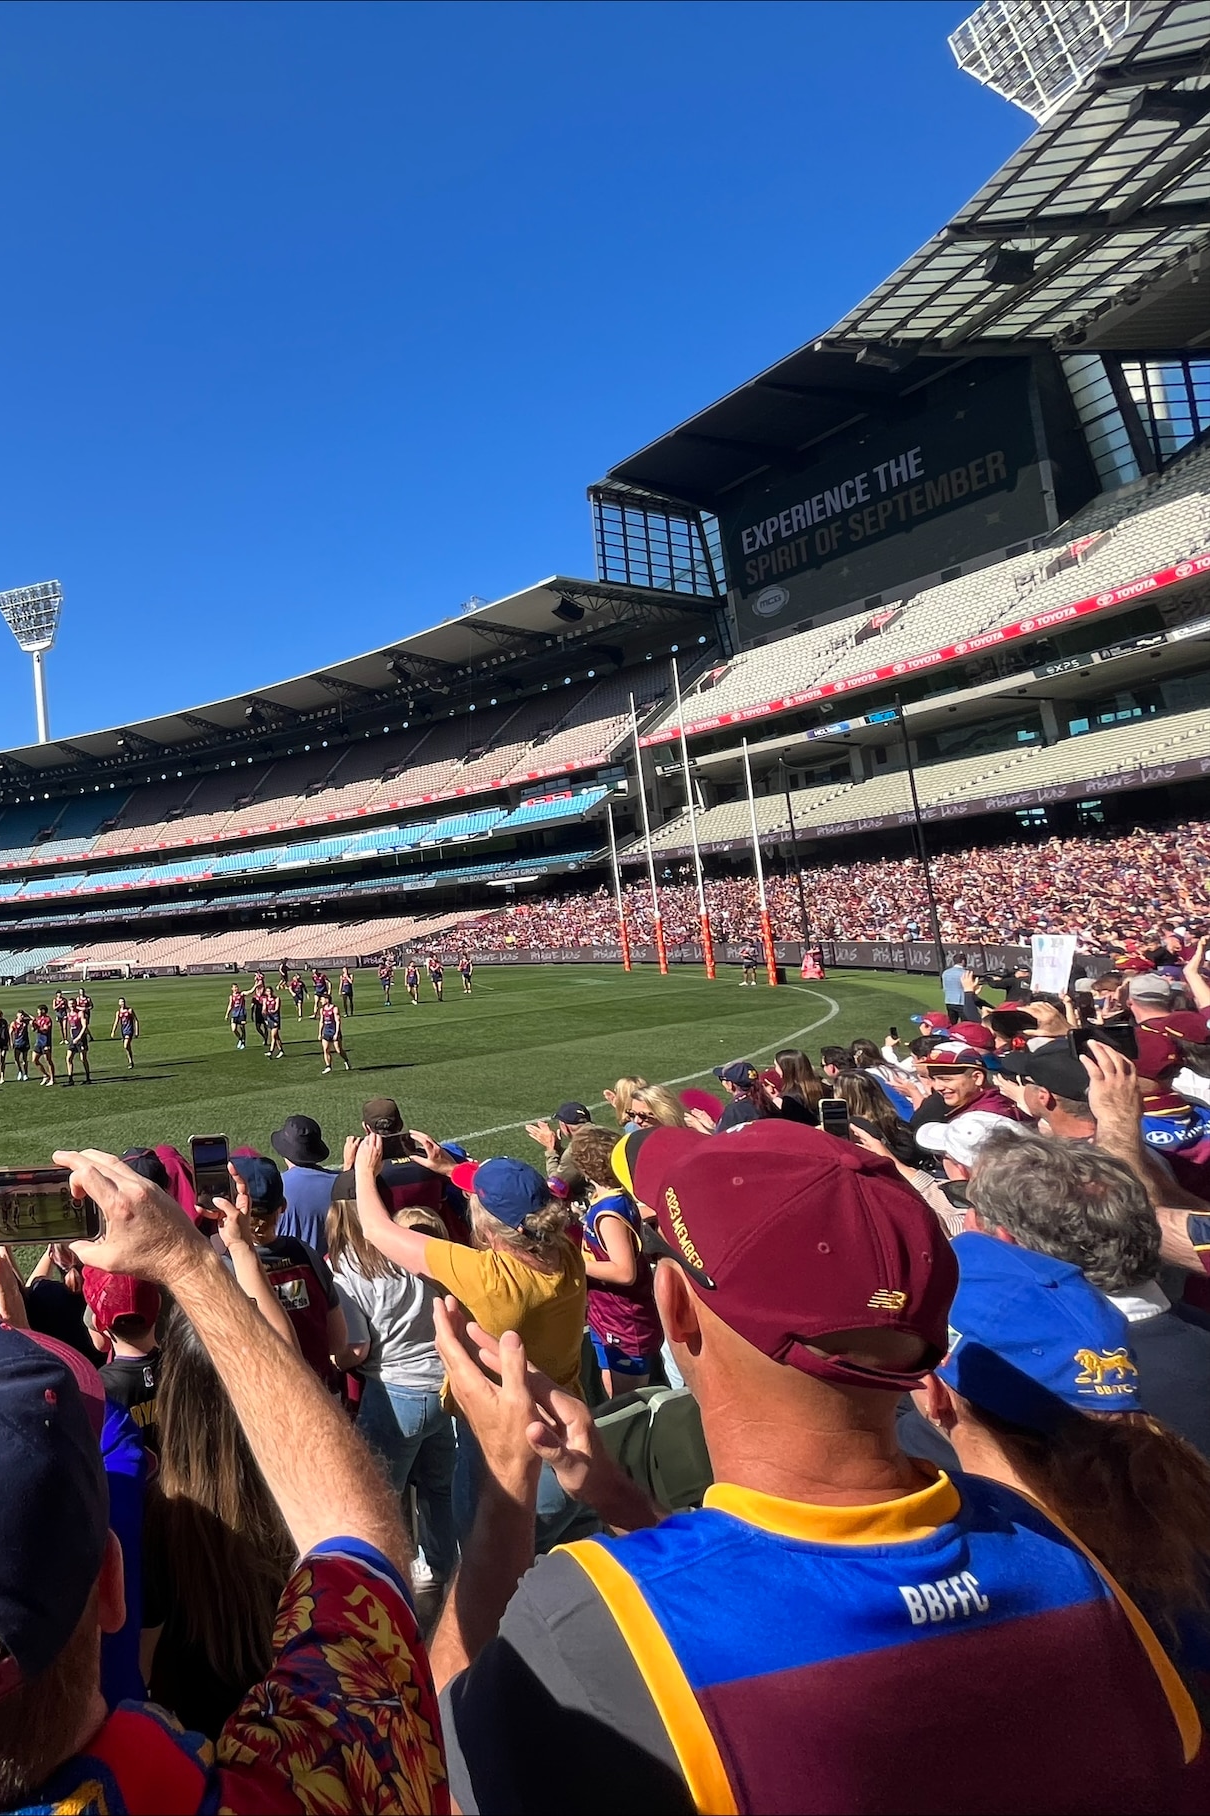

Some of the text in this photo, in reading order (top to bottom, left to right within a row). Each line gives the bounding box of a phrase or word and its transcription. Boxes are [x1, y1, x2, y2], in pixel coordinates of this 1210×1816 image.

[741, 446, 925, 554] EXPERIENCE THE
[745, 450, 1007, 585] SPIRIT OF SEPTEMBER
[1115, 578, 1157, 599] TOYOTA
[1036, 607, 1077, 626] TOYOTA
[968, 632, 1004, 649] TOYOTA
[907, 652, 942, 669] TOYOTA
[846, 672, 878, 687] TOYOTA
[795, 689, 822, 703] TOYOTA
[742, 705, 771, 718] TOYOTA
[694, 719, 720, 730] TOYOTA
[648, 732, 673, 742] TOYOTA
[457, 866, 548, 883] MELBOURNE CRICKET GROUND
[665, 1186, 704, 1269] 2023 MEMBER
[898, 1571, 990, 1625] BBFFC
